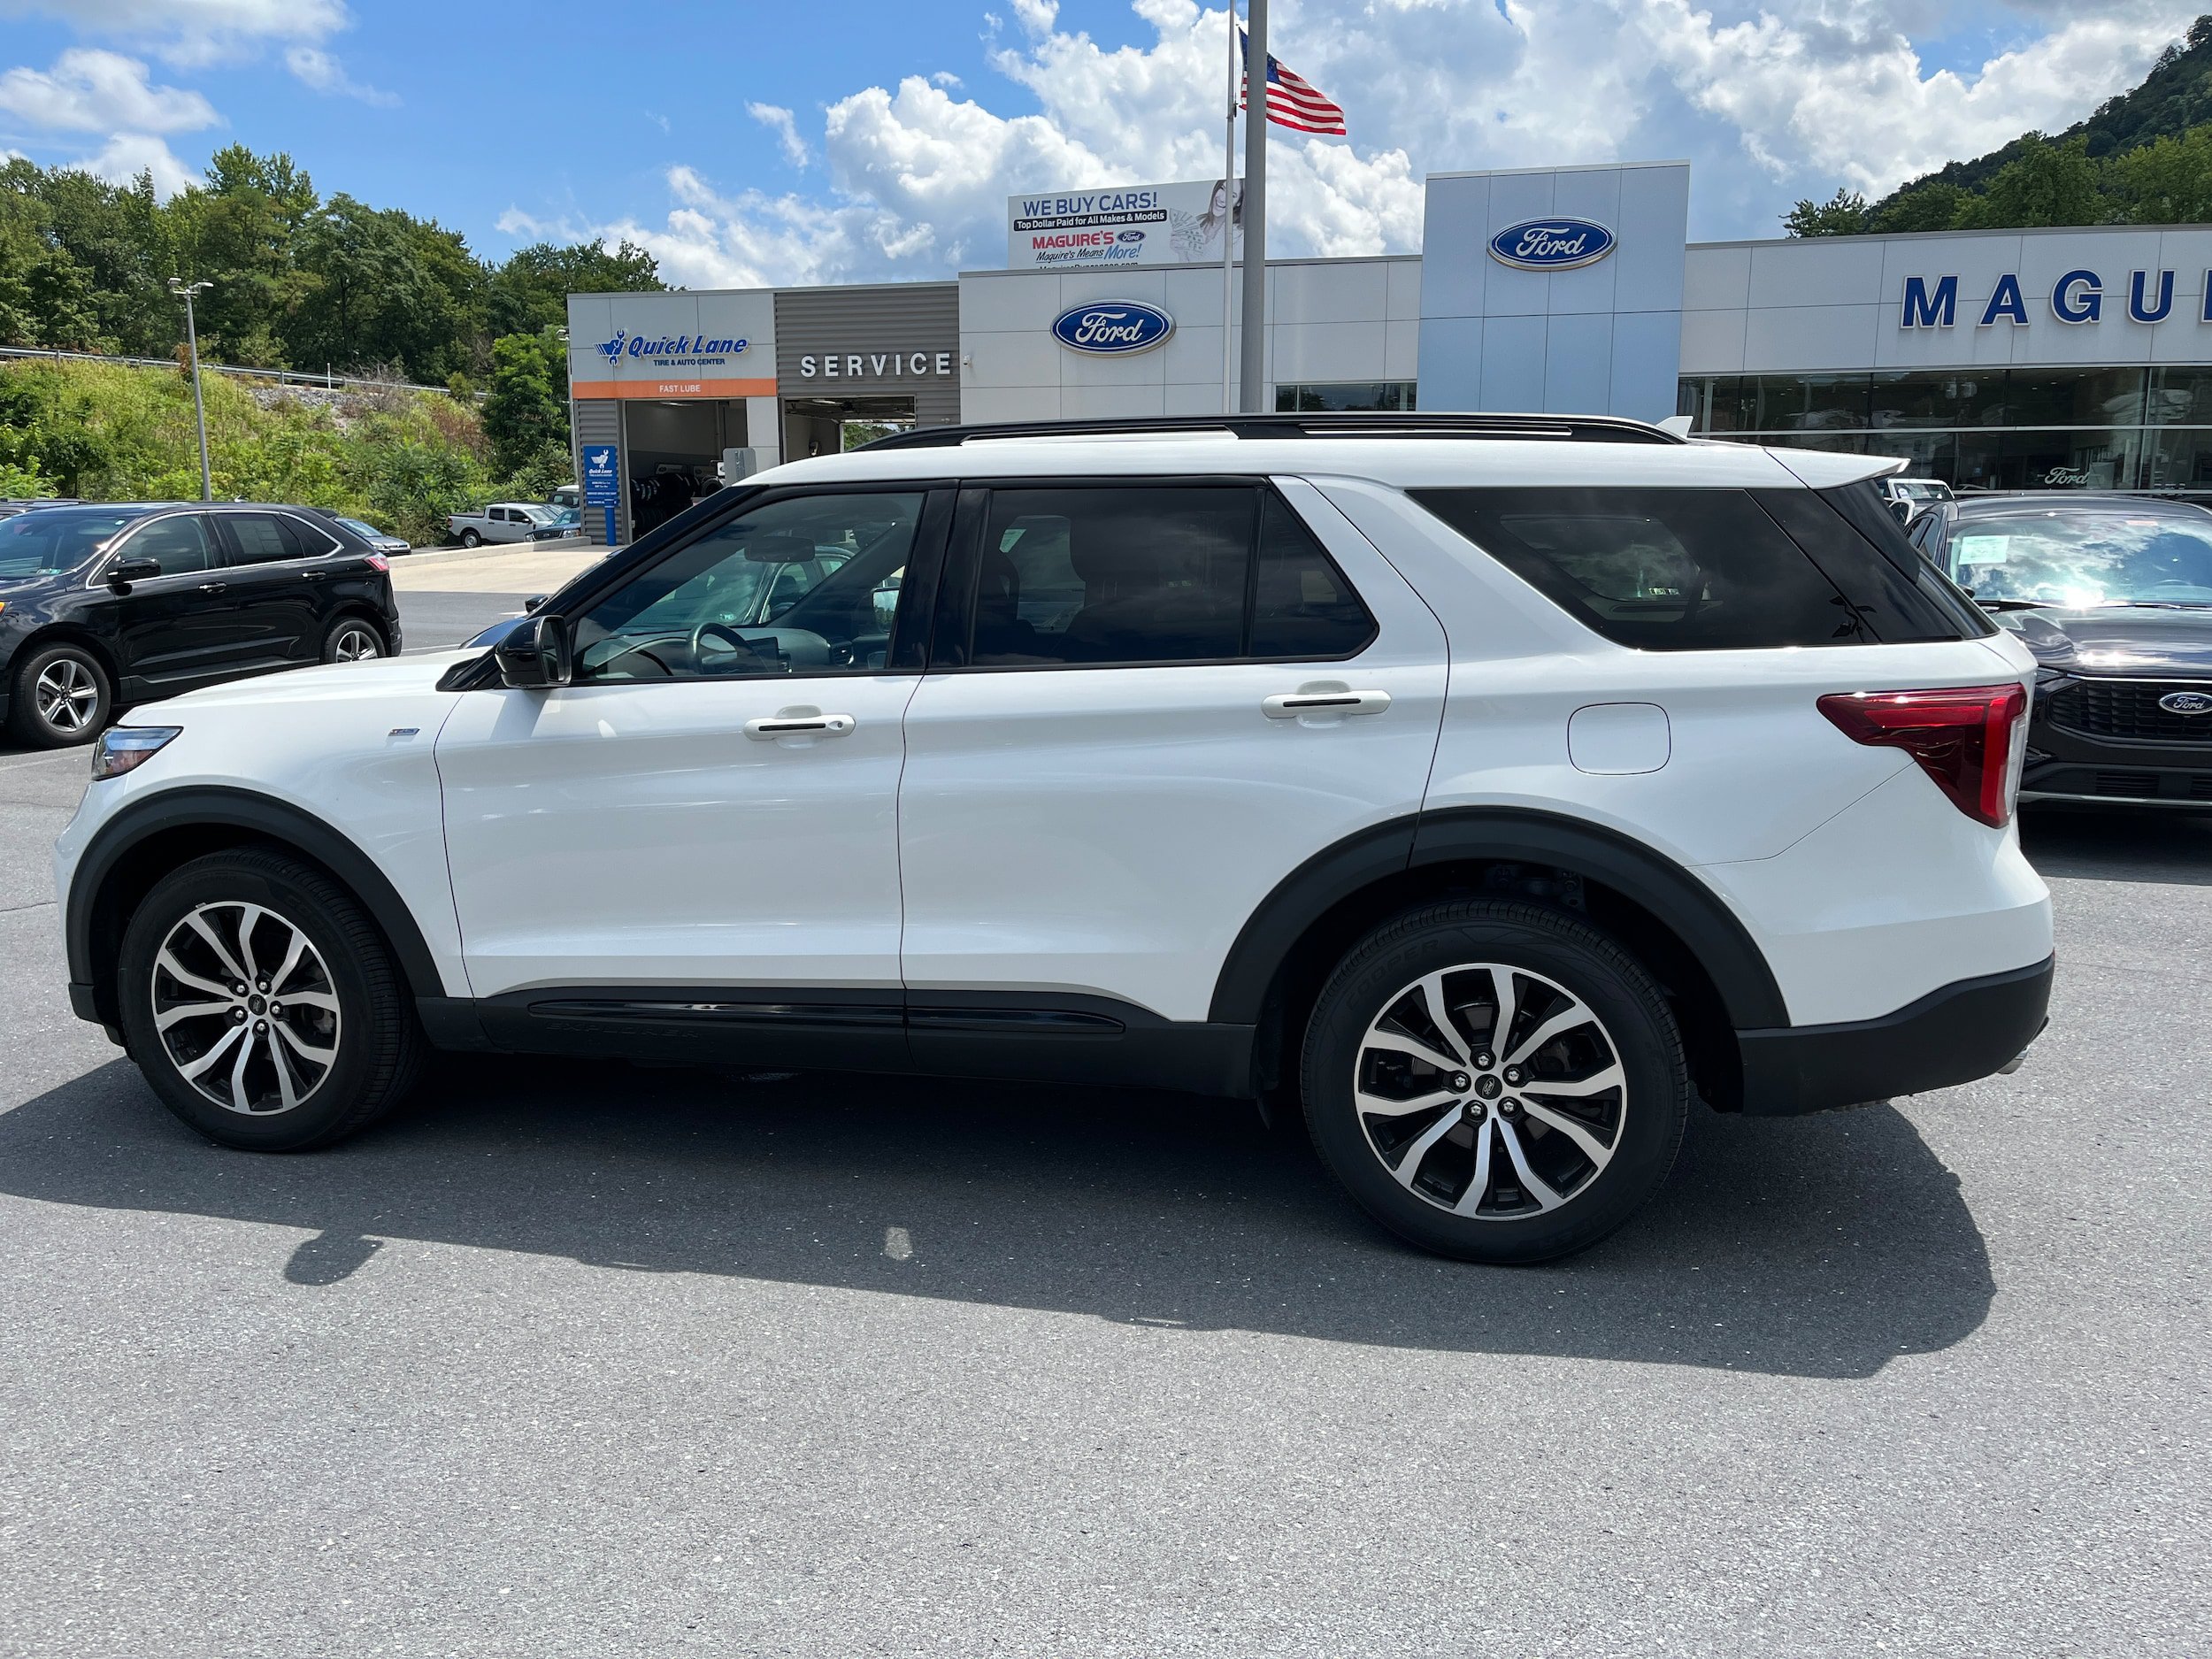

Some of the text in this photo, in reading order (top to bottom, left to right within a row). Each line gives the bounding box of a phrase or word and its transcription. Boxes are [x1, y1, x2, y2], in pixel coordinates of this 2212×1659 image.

[1023, 192, 1157, 217] WE BUY CARS!
[1017, 220, 1032, 231] Top
[1033, 218, 1055, 228] Dollar
[1056, 217, 1074, 227] Paid
[1075, 216, 1087, 226] for
[1087, 214, 1099, 224] All
[1100, 213, 1125, 224] Makes
[1134, 211, 1164, 221] Models
[1033, 231, 1141, 250] MAGUIRE'S Ford
[1516, 227, 1587, 257] Ford
[1035, 243, 1142, 263] Maguire's Means More!
[1075, 312, 1144, 343] Ford
[628, 334, 749, 358] Quick Lane
[801, 352, 951, 378] SERVICE
[2045, 466, 2090, 485] Ford
[2173, 695, 2206, 710] Ford
